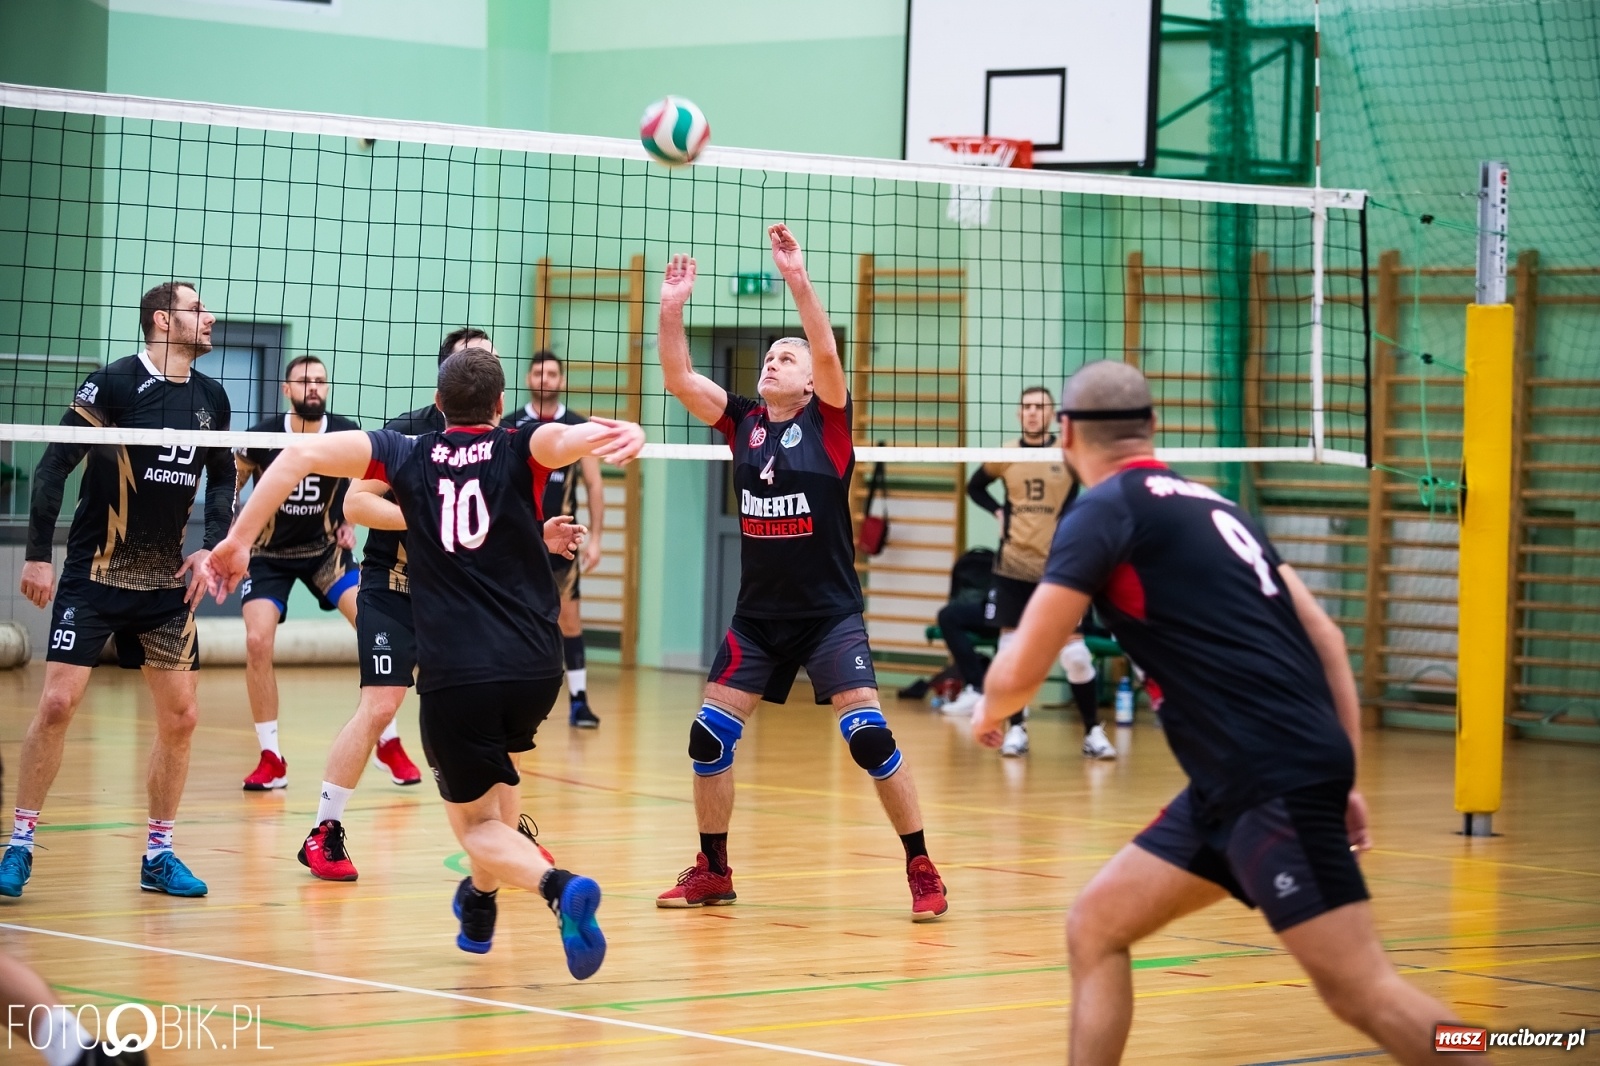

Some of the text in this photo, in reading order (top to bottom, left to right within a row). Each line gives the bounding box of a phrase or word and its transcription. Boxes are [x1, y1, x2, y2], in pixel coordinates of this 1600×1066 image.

[143, 467, 197, 487] AGROTIM
[759, 455, 775, 486] 4
[1024, 478, 1046, 501] 13
[438, 478, 490, 553] 10
[741, 516, 814, 537] NORTHERN
[1210, 508, 1279, 598] 9
[51, 628, 77, 651] 99
[372, 654, 392, 675] 10
